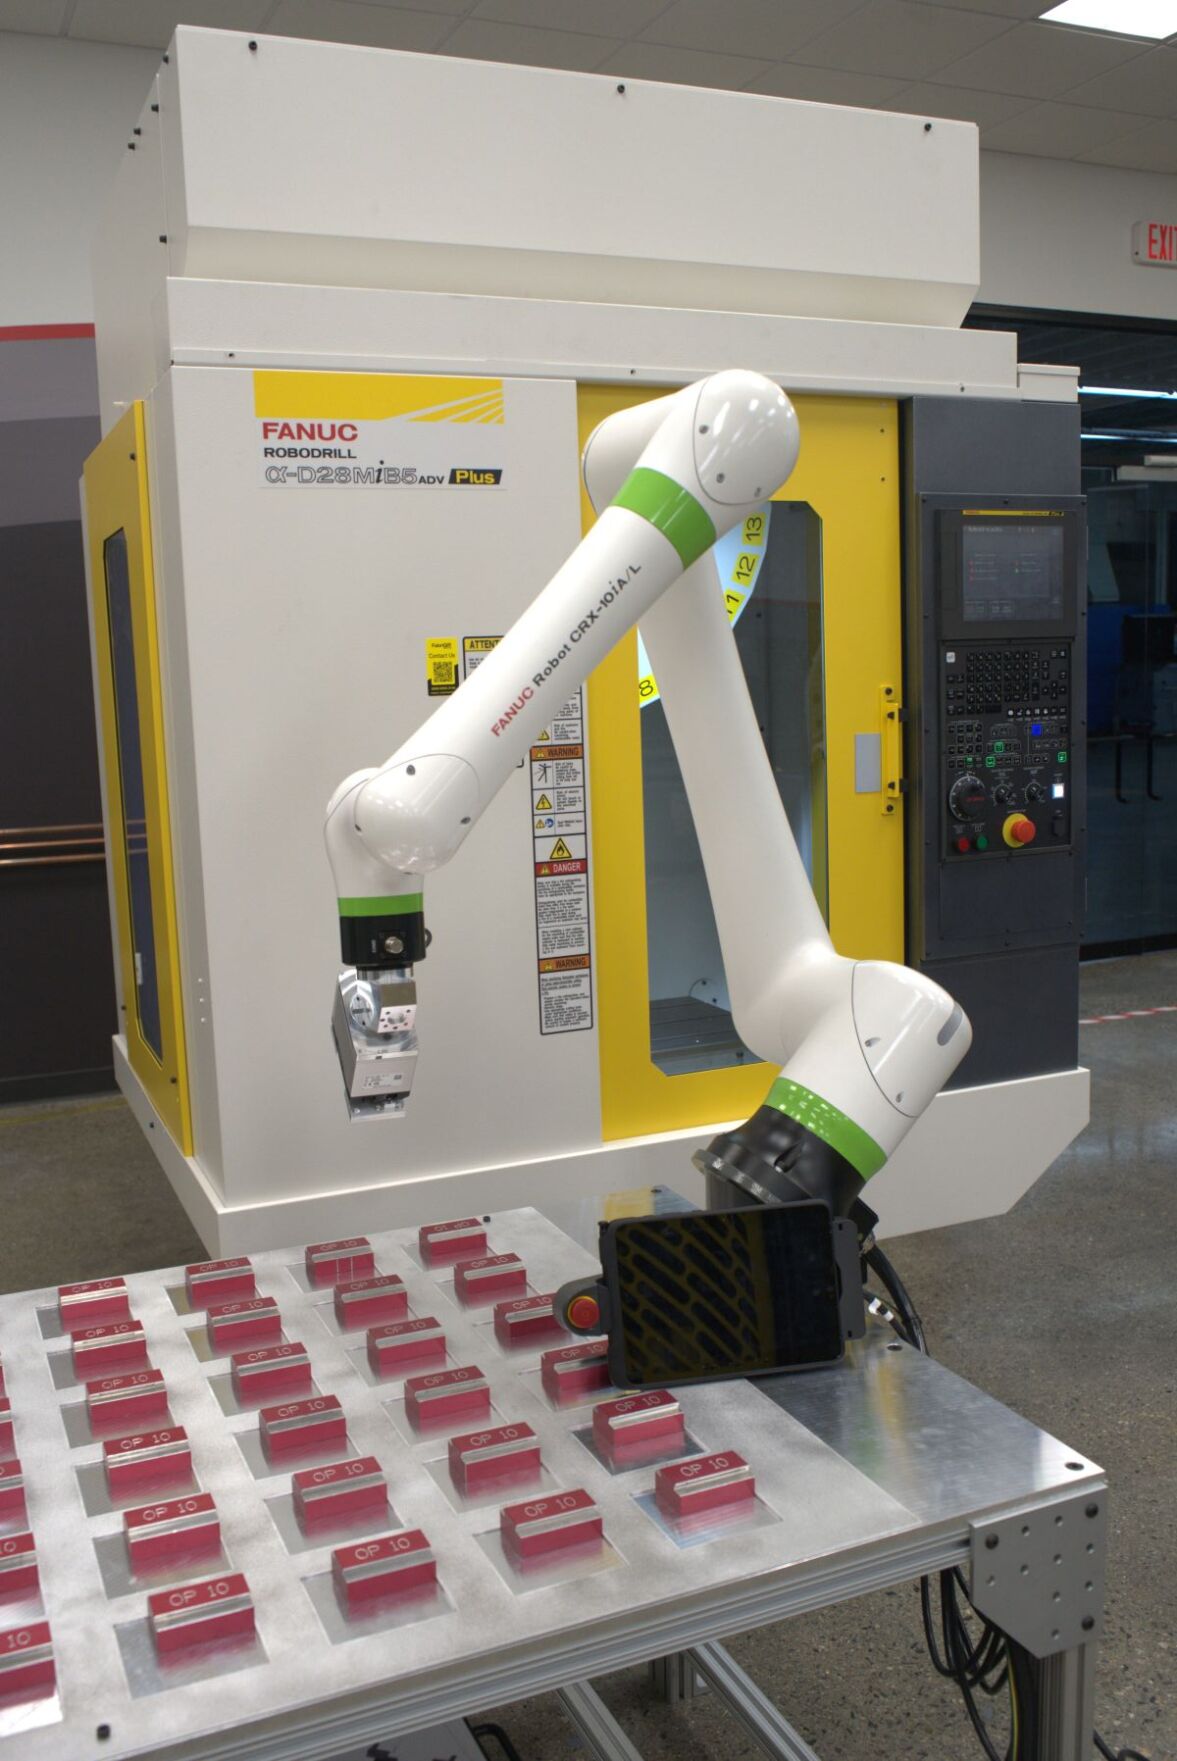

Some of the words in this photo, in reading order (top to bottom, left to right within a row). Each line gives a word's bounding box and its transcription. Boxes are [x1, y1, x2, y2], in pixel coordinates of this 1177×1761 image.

[262, 422, 358, 441] FANUC
[263, 447, 357, 459] ROBODRILL
[455, 470, 496, 484] Plus
[746, 517, 762, 541] 13
[736, 555, 756, 580] 12
[491, 687, 535, 736] FANUC
[532, 644, 572, 687] Robot
[569, 564, 642, 643] CRX-10iA/L
[638, 680, 654, 697] 8
[548, 747, 579, 757] WARNING
[553, 863, 581, 873] DANGER
[556, 957, 586, 968] WARNING
[320, 1243, 337, 1251] OP
[200, 1263, 217, 1272] OP
[471, 1260, 487, 1268] OP
[72, 1284, 91, 1292] OP
[98, 1281, 112, 1289] 10
[350, 1281, 368, 1290] OP
[222, 1304, 241, 1313] OP
[249, 1301, 263, 1309] 10
[513, 1301, 531, 1309] OP
[85, 1328, 106, 1337] OP
[113, 1324, 129, 1333] 10
[384, 1325, 404, 1334] OP
[410, 1320, 426, 1329] 10
[248, 1351, 268, 1361] OP
[275, 1347, 292, 1356] 10
[561, 1349, 580, 1358] OP
[587, 1344, 604, 1354] 10
[101, 1378, 123, 1389] OP
[131, 1374, 148, 1384] 10
[423, 1375, 444, 1386] OP
[451, 1370, 469, 1380] 10
[278, 1405, 299, 1416] OP
[307, 1400, 325, 1411] 10
[615, 1400, 636, 1412] OP
[642, 1395, 661, 1406] 10
[120, 1437, 144, 1449] OP
[152, 1432, 171, 1443] 10
[470, 1433, 492, 1446] OP
[499, 1428, 518, 1440] 10
[312, 1469, 336, 1482] OP
[345, 1463, 364, 1475] 10
[679, 1463, 702, 1477] OP
[708, 1457, 729, 1470] 10
[142, 1507, 168, 1521] OP
[177, 1500, 197, 1513] 10
[524, 1503, 548, 1517] OP
[556, 1496, 576, 1510] 10
[355, 1544, 380, 1560] OP
[389, 1537, 410, 1552] 10
[169, 1590, 197, 1607] OP
[207, 1582, 229, 1598] 10
[7, 1631, 31, 1649] 10
